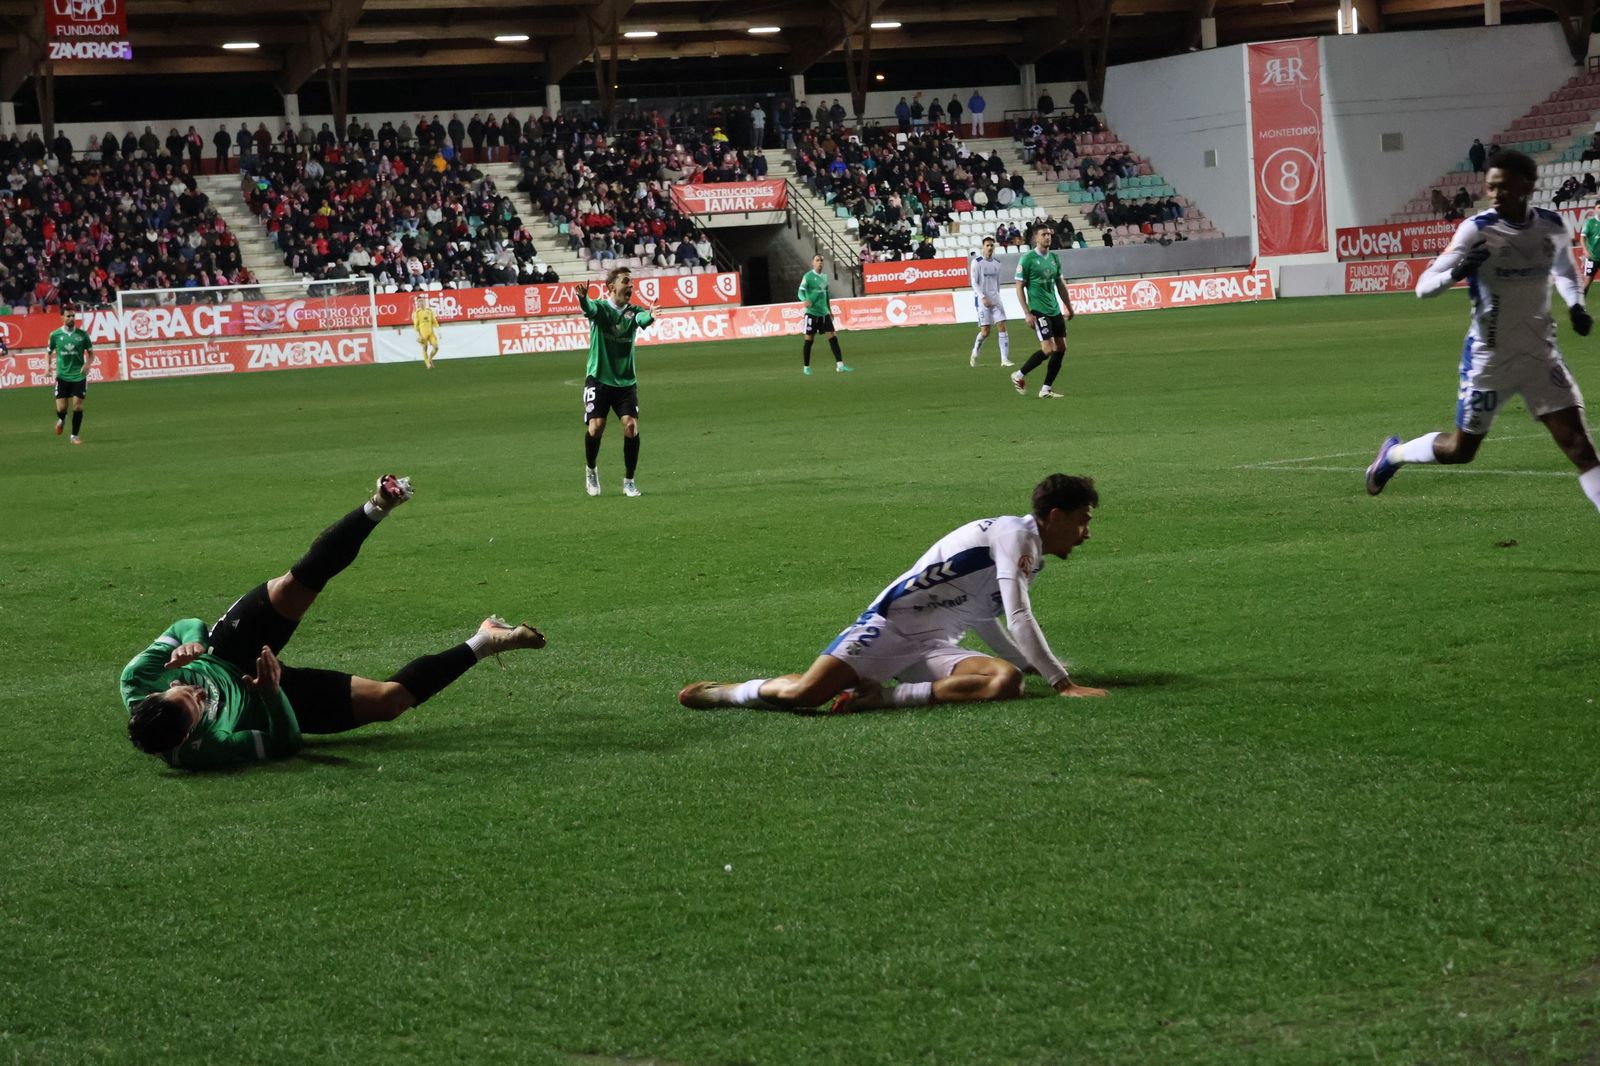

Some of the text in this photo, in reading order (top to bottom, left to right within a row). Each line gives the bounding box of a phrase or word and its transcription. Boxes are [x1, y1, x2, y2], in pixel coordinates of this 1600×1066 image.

[56, 23, 119, 36] FUNDACIÓN
[1259, 126, 1316, 139] MONTETORO
[1280, 160, 1300, 192] 8
[1338, 228, 1402, 256] cubiex
[192, 304, 233, 337] CF
[703, 313, 730, 337] CF
[130, 348, 230, 370] Sumiller
[246, 337, 369, 369] ZAMORA CF
[1472, 390, 1498, 412] 20
